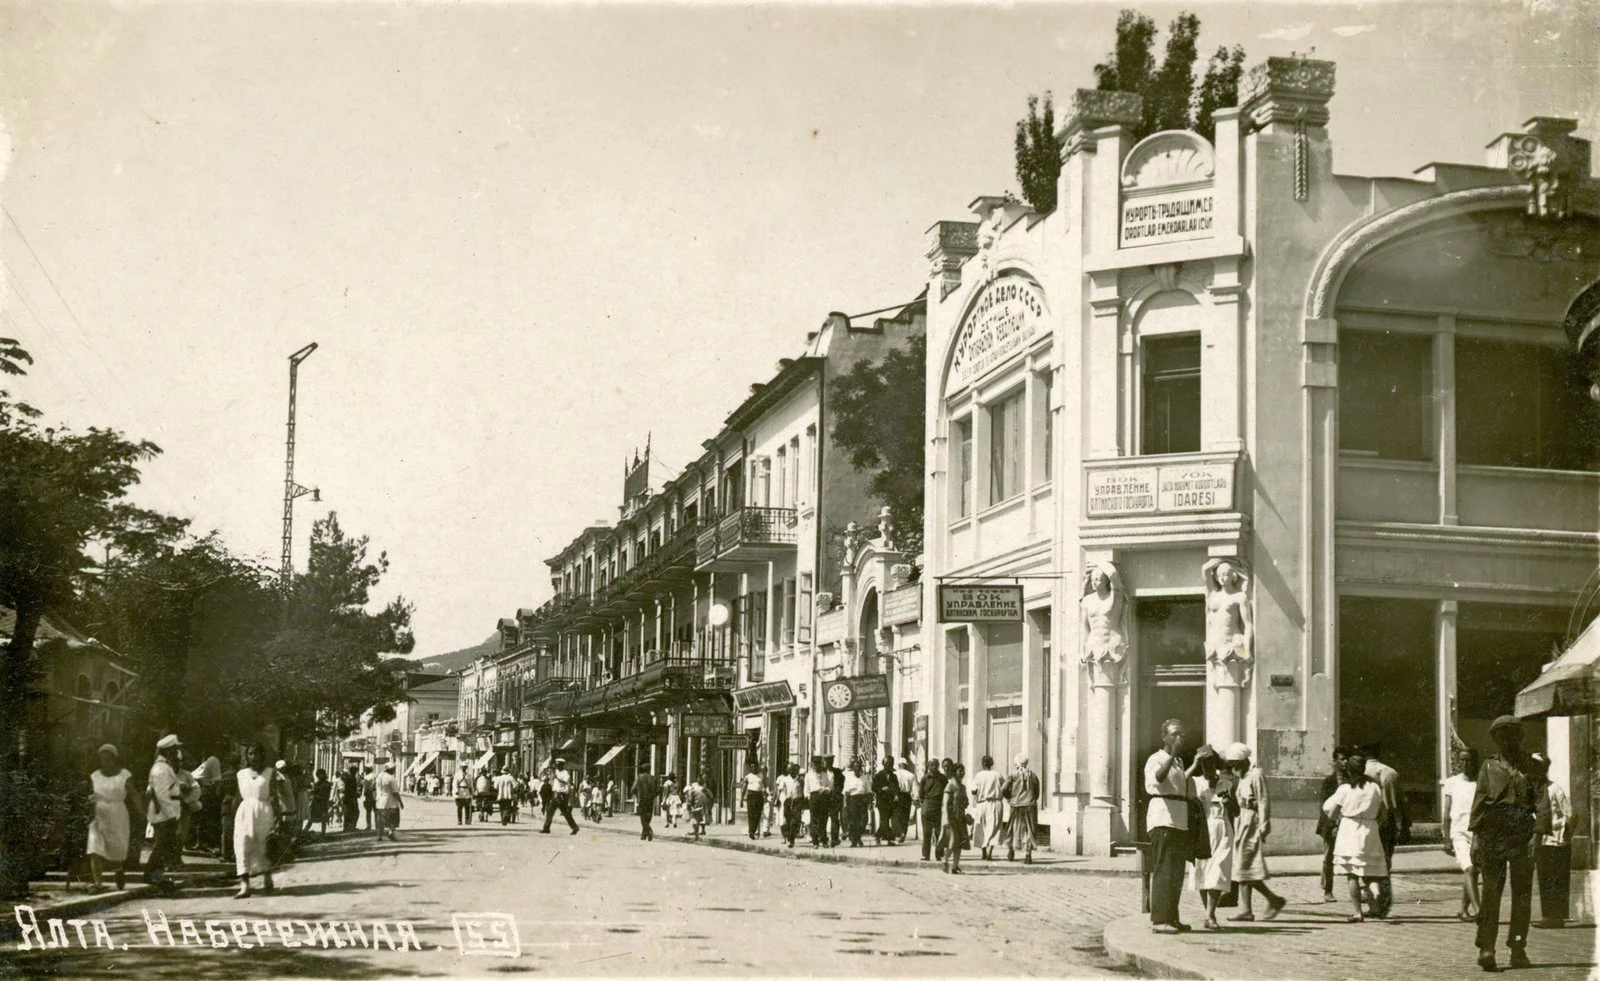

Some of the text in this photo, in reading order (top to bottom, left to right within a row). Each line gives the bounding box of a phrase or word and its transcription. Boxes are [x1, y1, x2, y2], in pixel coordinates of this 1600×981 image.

[995, 285, 1017, 305] ДЕЛО
[1019, 287, 1042, 318] СССР
[1095, 483, 1150, 496] УПРАВЛЕНИЕ
[1174, 492, 1215, 507] IDARESI
